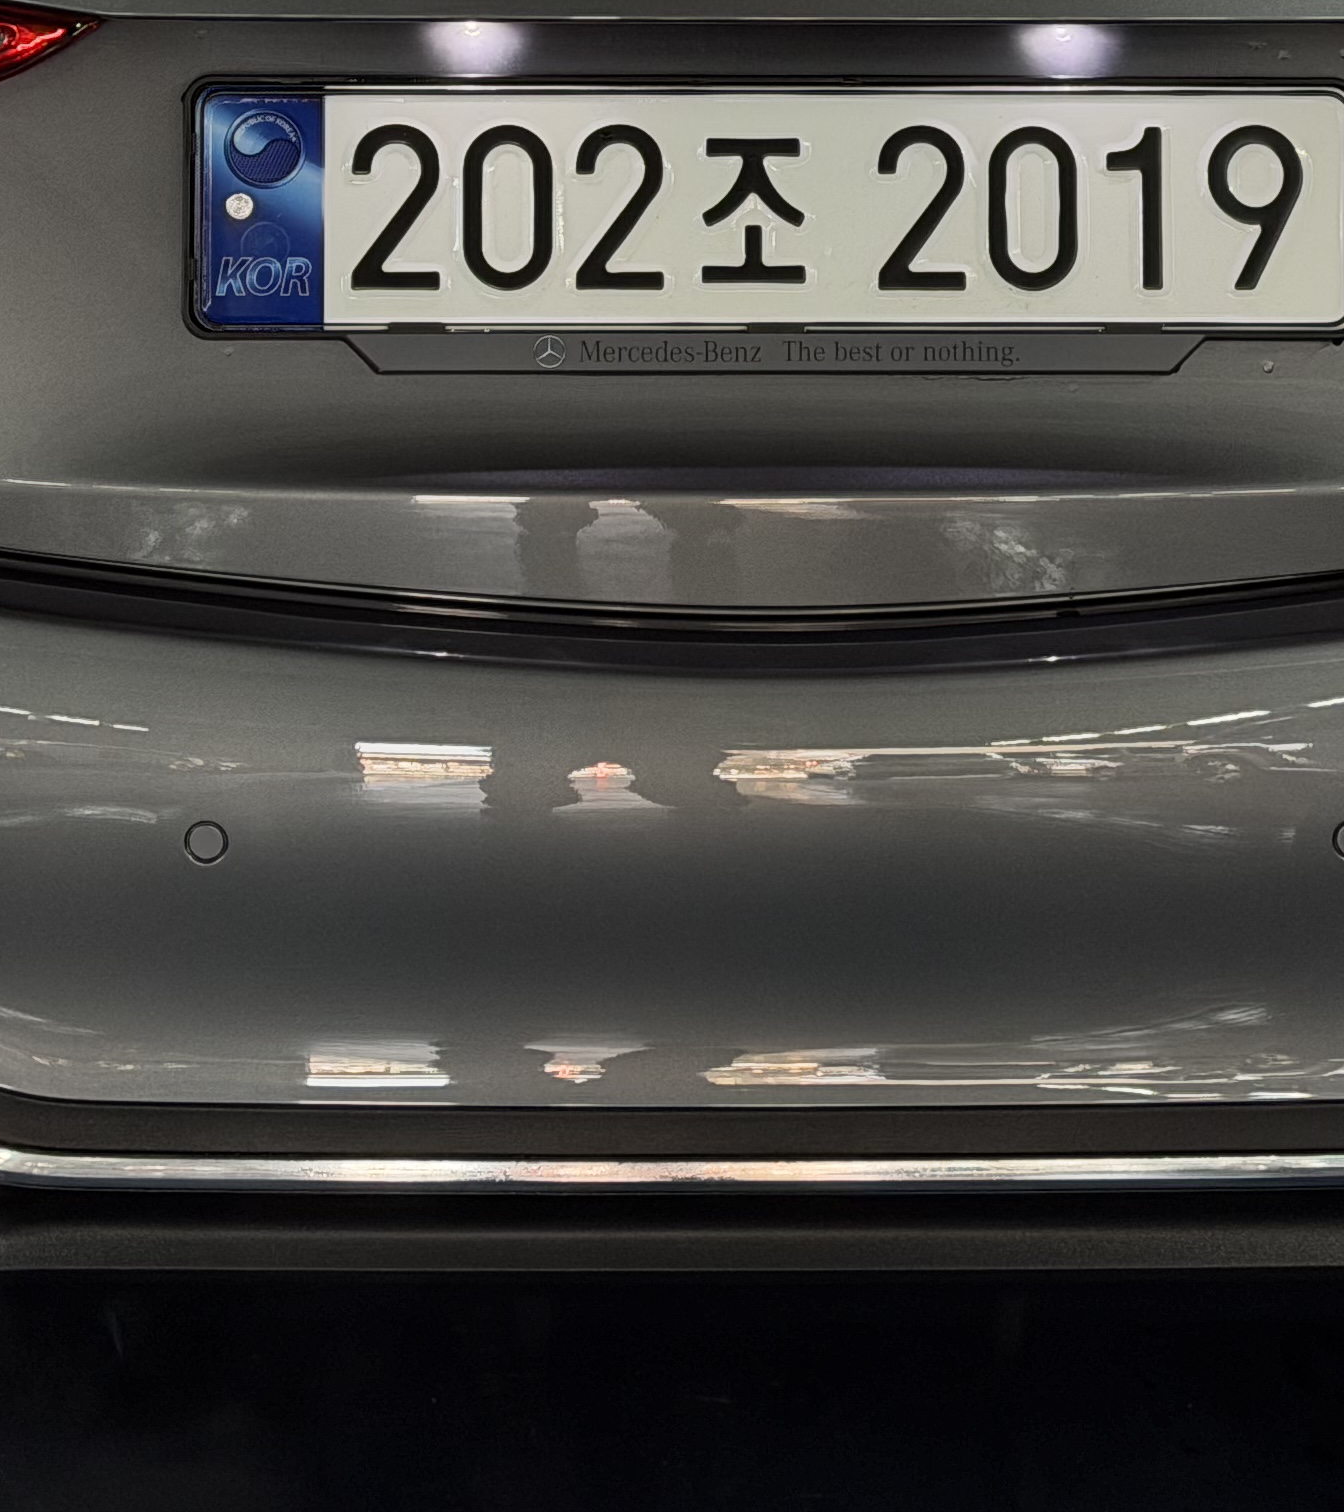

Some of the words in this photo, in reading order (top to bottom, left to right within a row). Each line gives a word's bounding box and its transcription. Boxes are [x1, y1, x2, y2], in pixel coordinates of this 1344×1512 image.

[349, 123, 807, 290] 202조
[876, 123, 1305, 291] 2019
[215, 256, 313, 297] KOR
[578, 340, 763, 363] Mercedes-Benz
[782, 340, 826, 363] The
[834, 340, 883, 363] best
[890, 345, 916, 363] or
[923, 340, 1021, 368] nothing.
